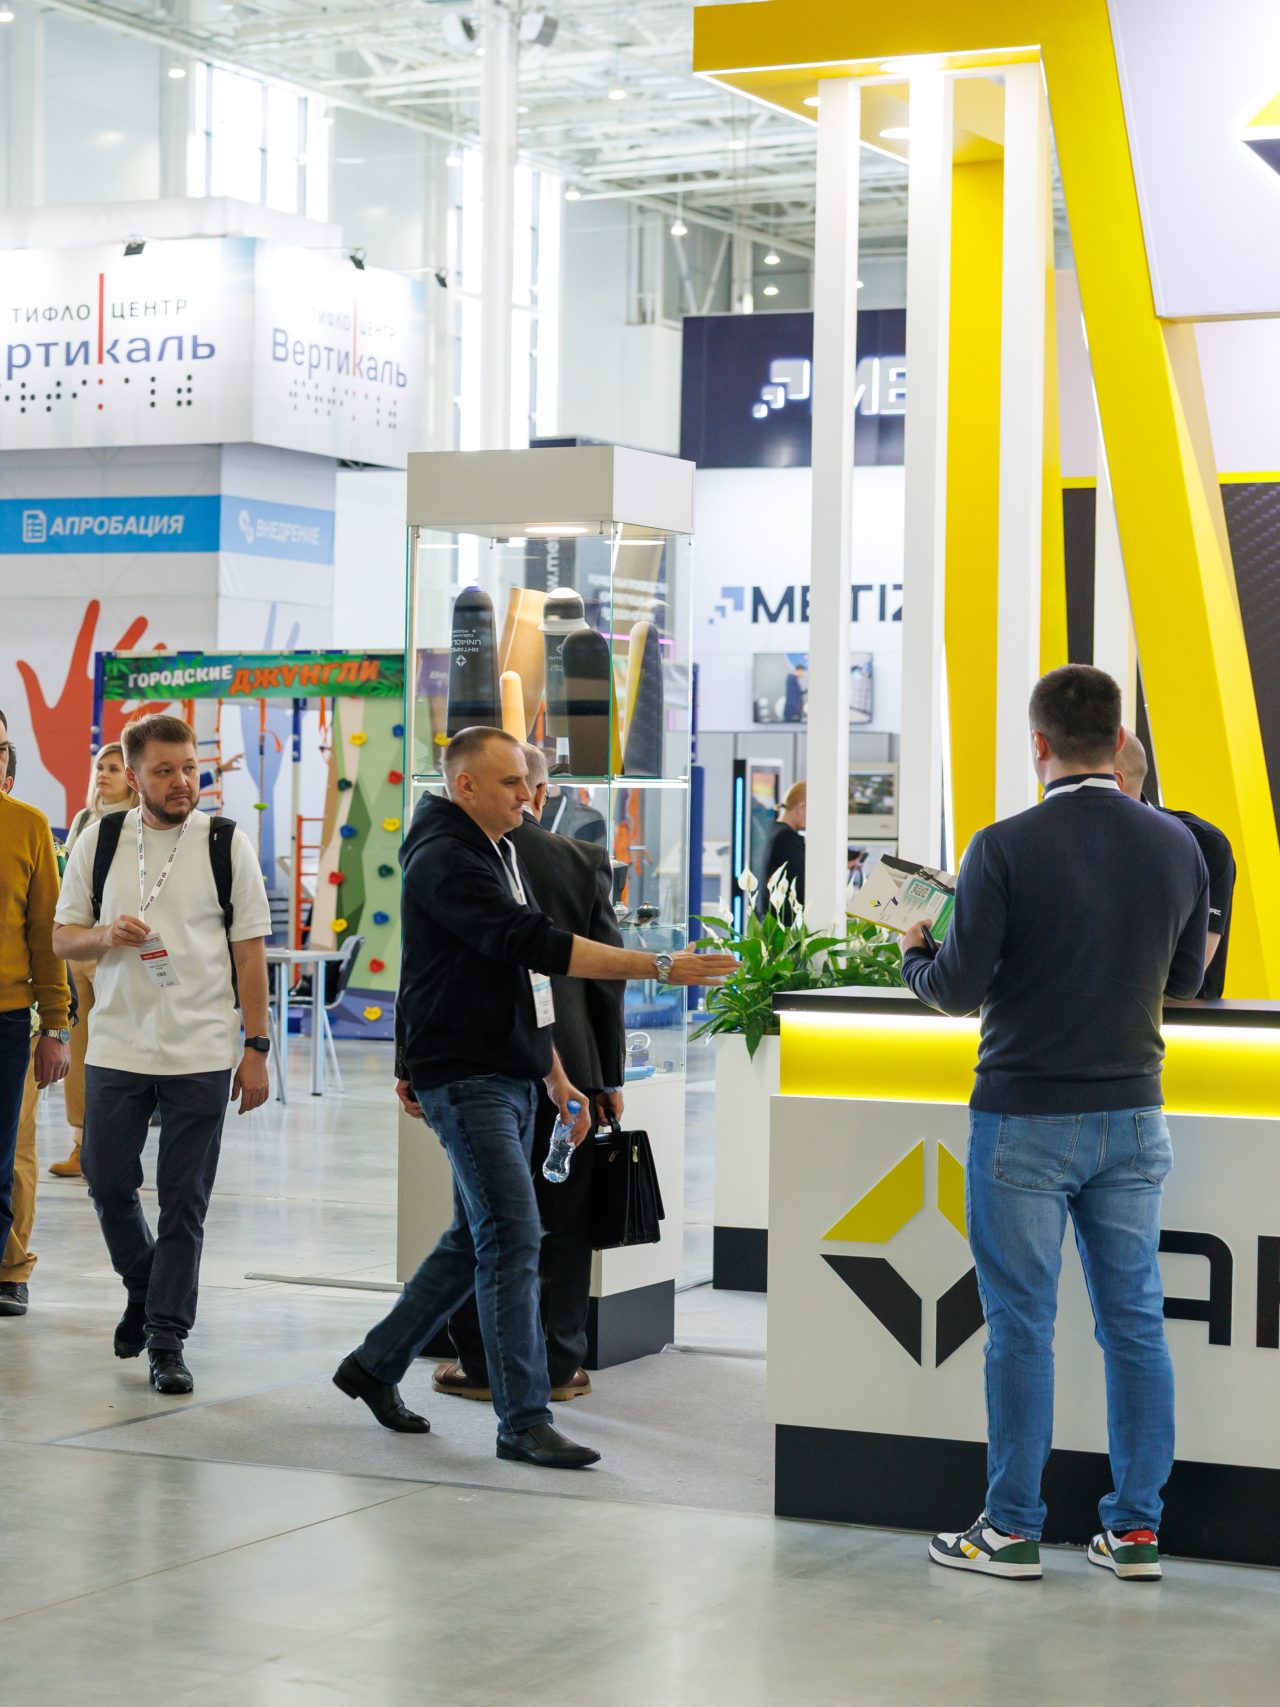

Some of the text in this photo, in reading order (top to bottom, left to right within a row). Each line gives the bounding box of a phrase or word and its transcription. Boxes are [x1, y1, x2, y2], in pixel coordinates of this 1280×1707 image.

[11, 299, 188, 324] ТИФЛО ЦЕНТР
[272, 328, 407, 388] Вертикаль
[50, 514, 184, 538] АПРОБАЦИЯ
[256, 517, 321, 546] ВНЕДРЕНИЕ
[128, 660, 381, 695] ГОРОДСКИЕ ДЖУНГЛИ
